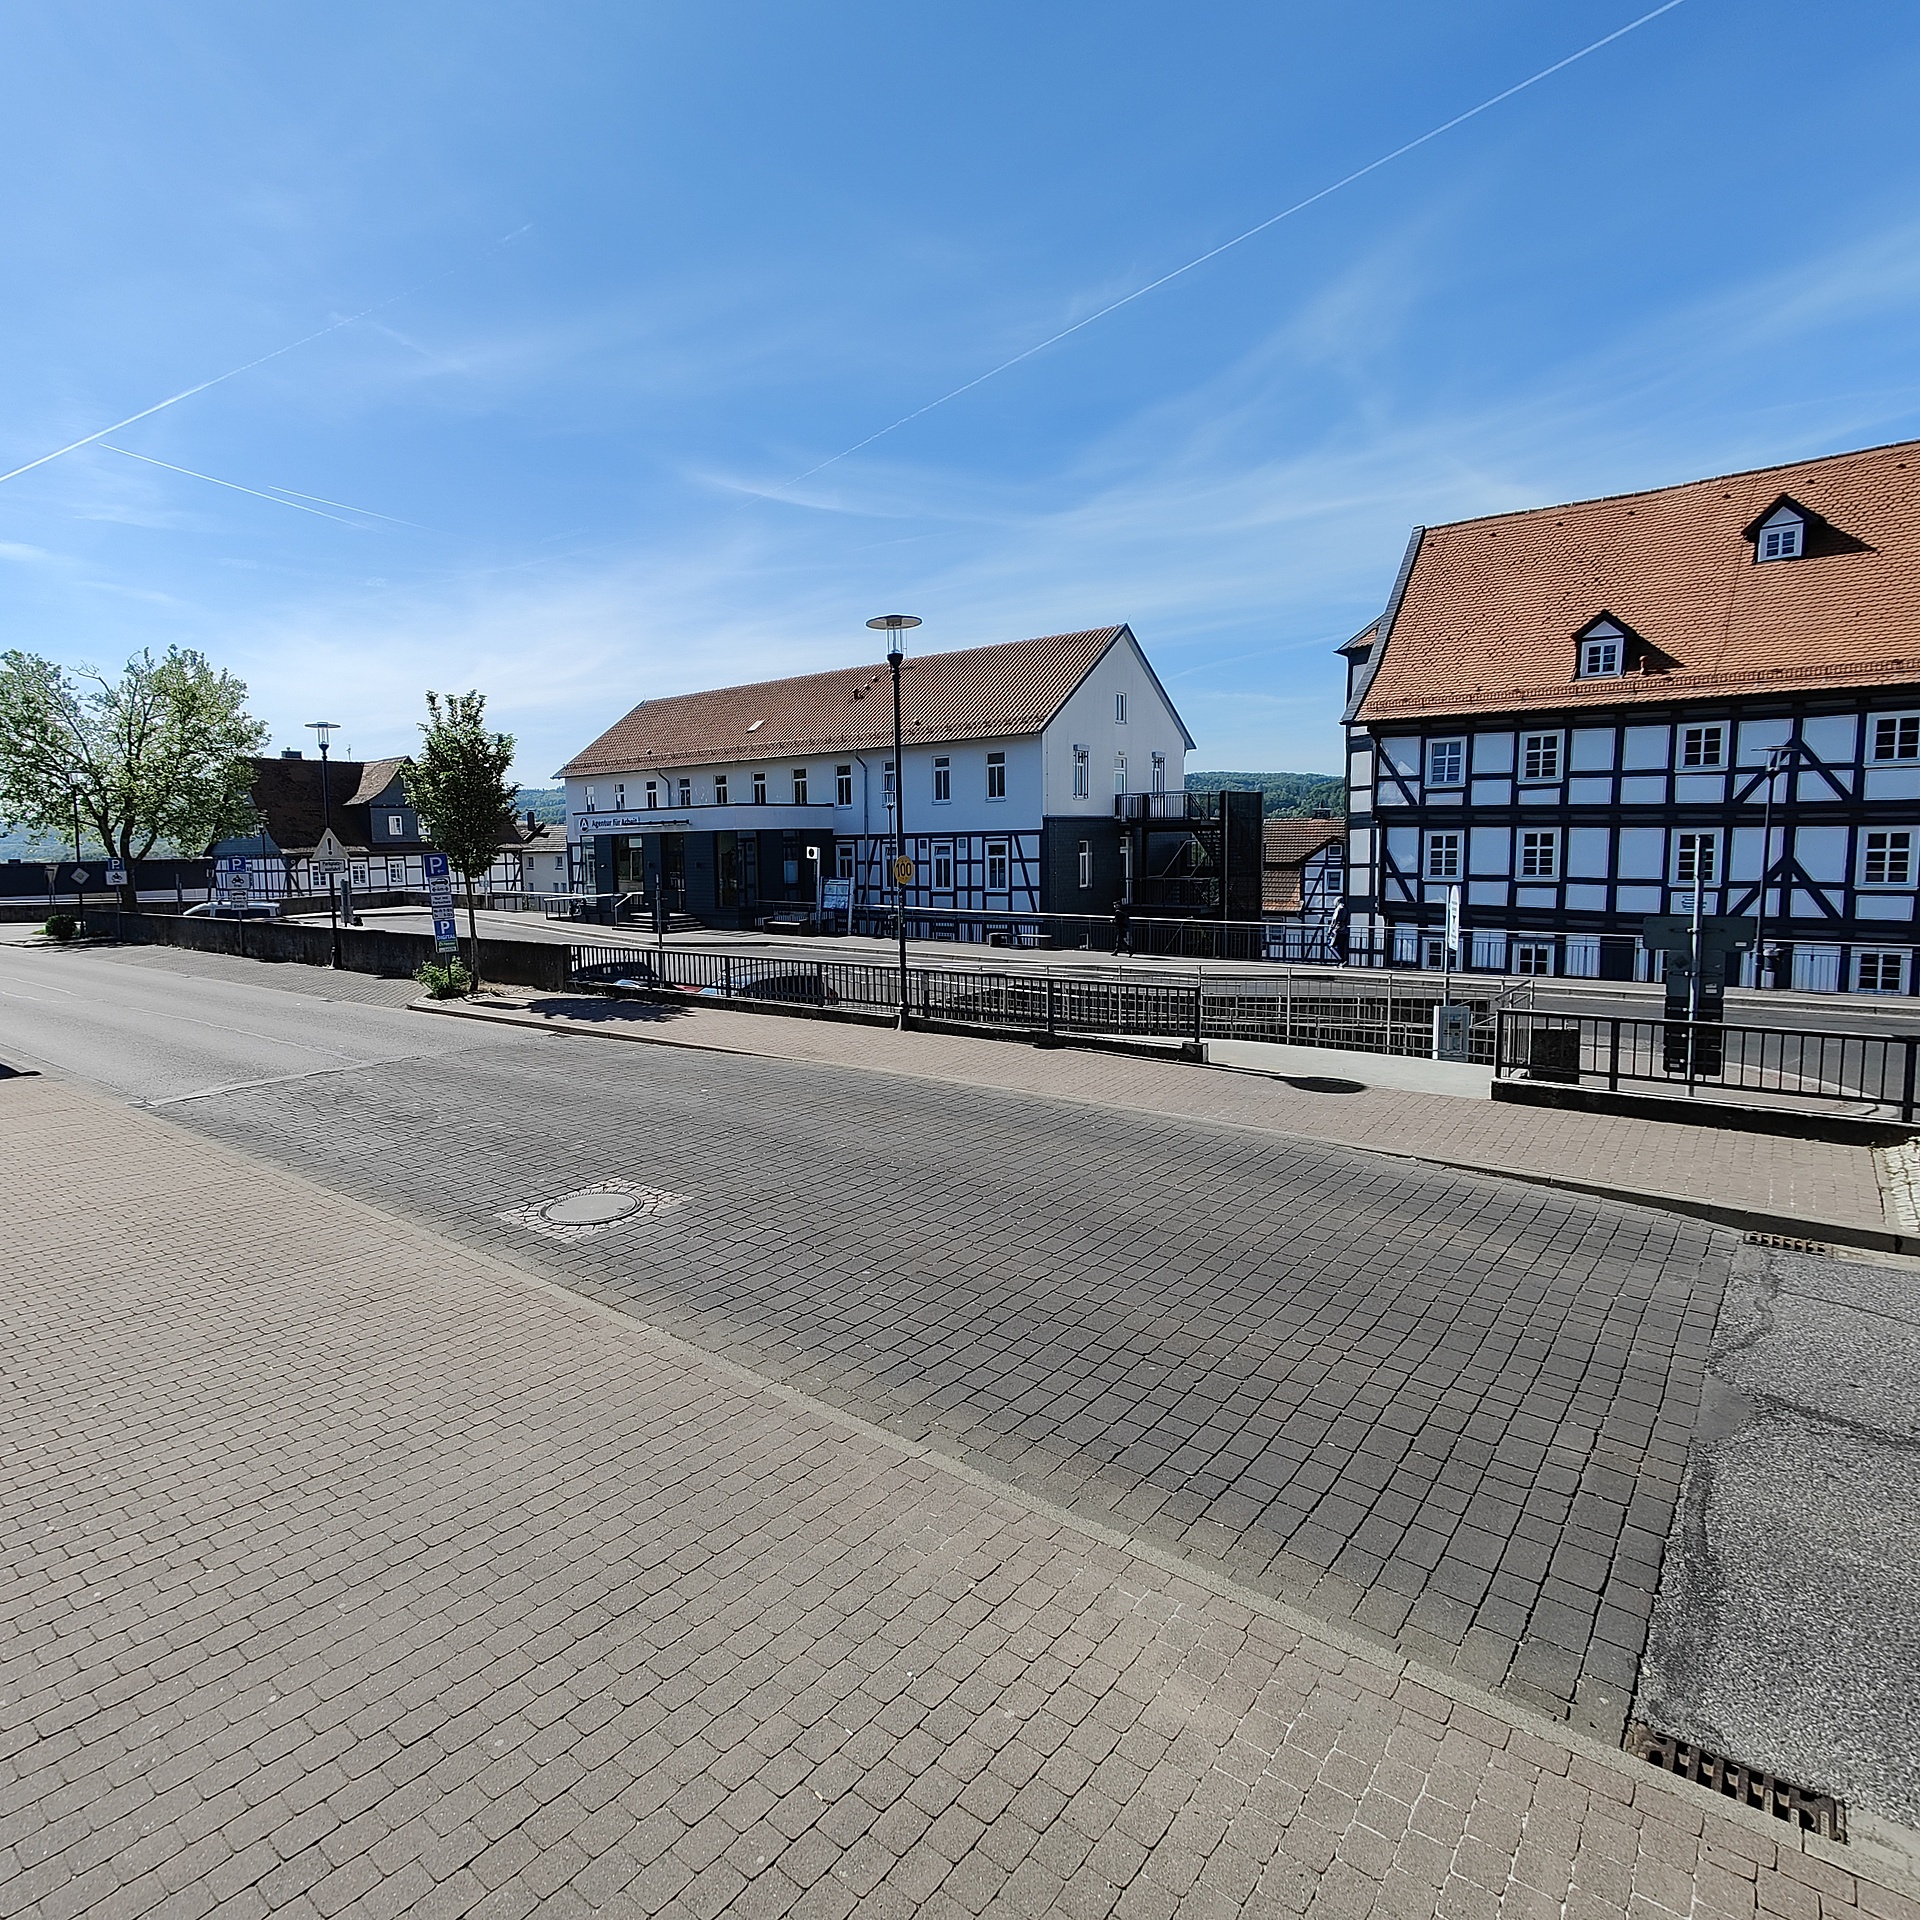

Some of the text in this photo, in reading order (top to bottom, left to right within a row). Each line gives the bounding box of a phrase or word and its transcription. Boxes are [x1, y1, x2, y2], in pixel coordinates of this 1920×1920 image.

[591, 819, 612, 829] Agentur
[111, 859, 120, 869] P
[232, 859, 242, 871] P
[429, 857, 442, 874] P
[895, 862, 912, 877] 100
[440, 920, 450, 934] P
